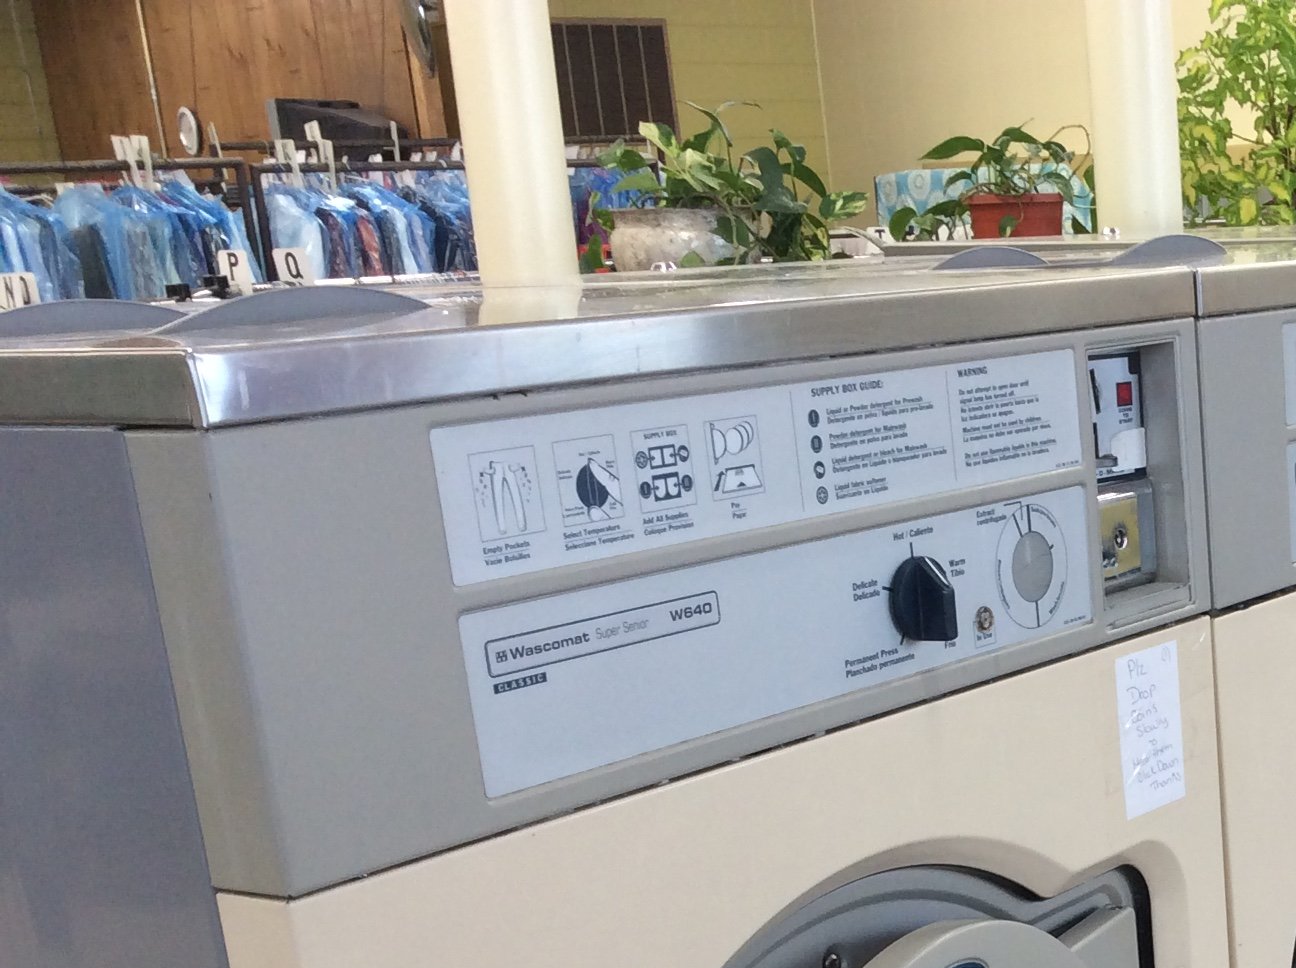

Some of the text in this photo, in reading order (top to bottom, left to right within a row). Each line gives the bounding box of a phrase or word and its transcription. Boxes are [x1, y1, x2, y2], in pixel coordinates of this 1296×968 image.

[226, 252, 239, 281] P
[284, 252, 304, 279] Q
[957, 366, 988, 377] WARNING
[811, 385, 840, 397] SUPPLY
[842, 383, 857, 394] BOX
[643, 432, 664, 440] SUPPLY
[976, 509, 995, 518] Extract
[563, 524, 621, 540] Select Temperature
[893, 532, 904, 541] Hot
[909, 526, 934, 538] Caliente
[483, 541, 530, 555] Empty Pockets
[949, 558, 966, 567] Warm
[951, 569, 965, 577] Tibio
[852, 579, 878, 591] Delicate
[853, 590, 880, 602] Delicado
[509, 601, 712, 661] Wascomat Super Senior W640
[844, 648, 899, 669] Permanent Press
[845, 652, 915, 679] Planchado permanente
[496, 673, 546, 693] CLASSIC
